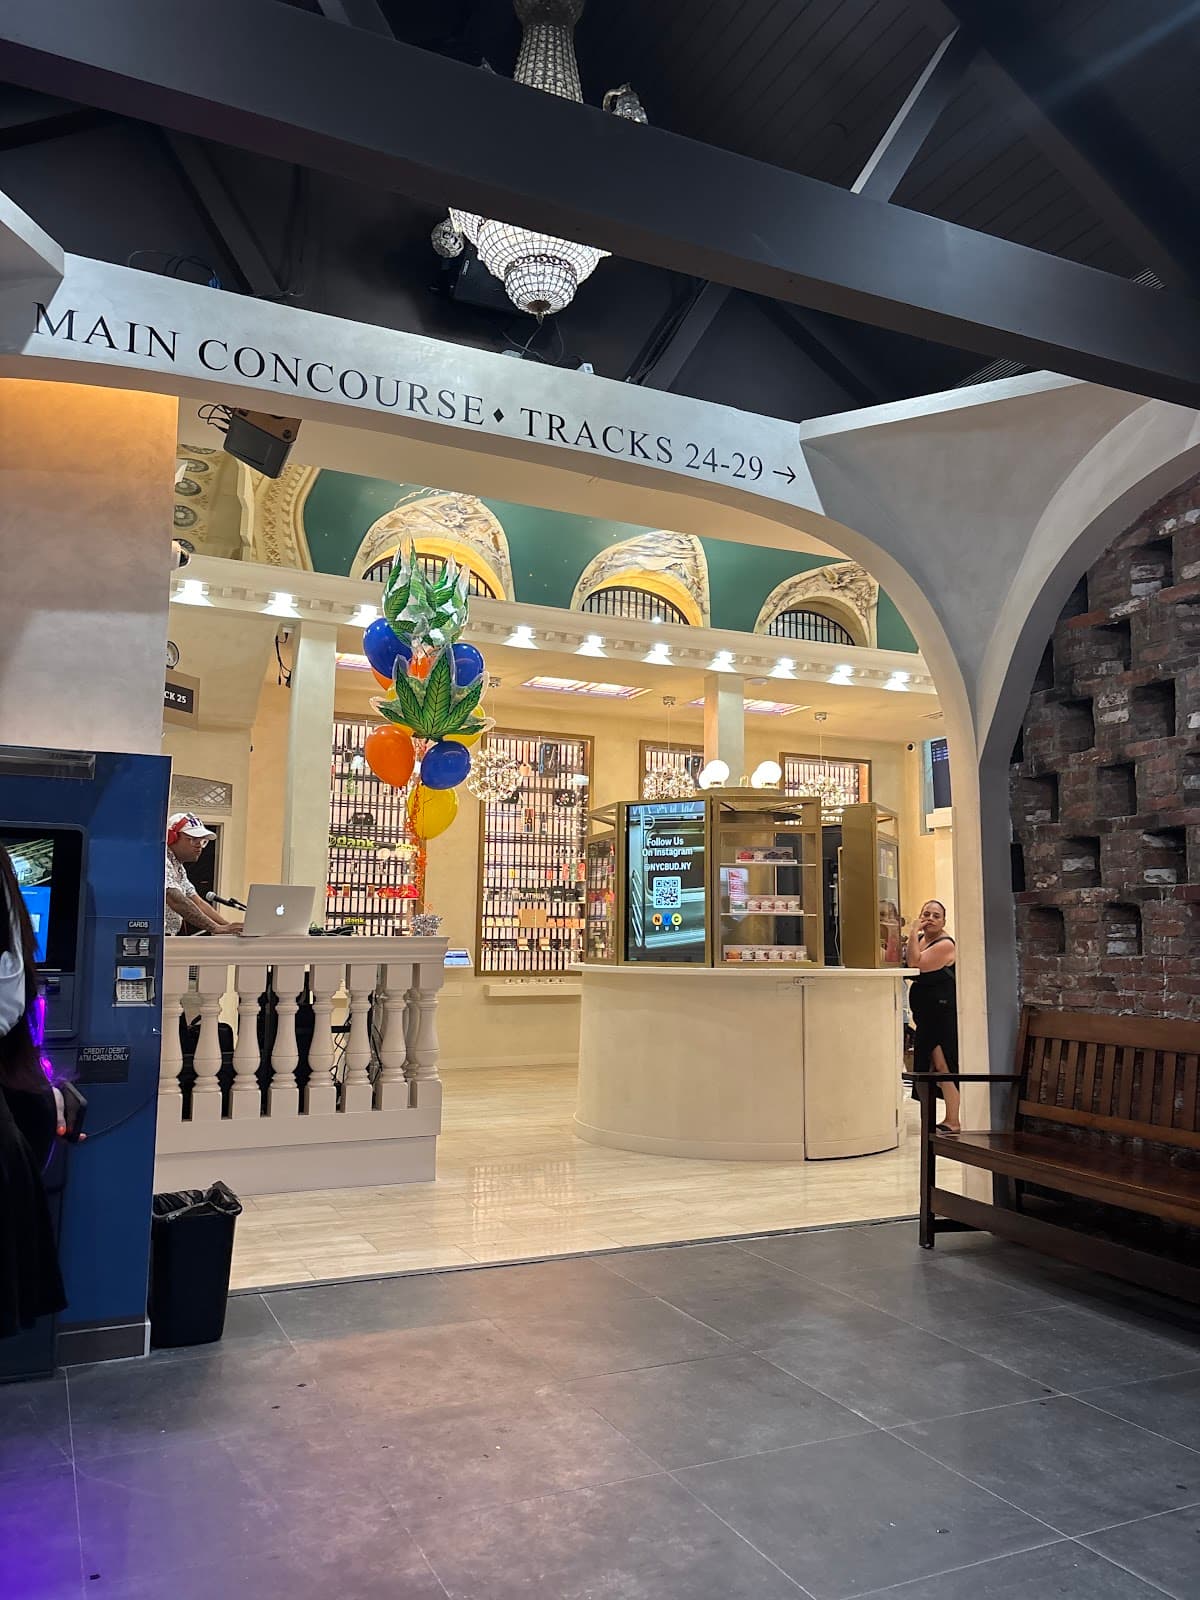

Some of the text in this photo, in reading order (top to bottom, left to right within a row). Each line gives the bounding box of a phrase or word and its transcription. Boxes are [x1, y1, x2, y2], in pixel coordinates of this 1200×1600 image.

[32, 301, 763, 481] MAIN CONCOURSE TRACKS 24-29
[177, 694, 187, 704] 25
[336, 835, 375, 848] dank
[646, 836, 684, 847] Follow Us
[642, 847, 693, 858] On Instagram
[644, 862, 692, 872] @NYCBUD.NY
[83, 1047, 105, 1055] CREDIT
[79, 1054, 92, 1062] ATM
[92, 1054, 113, 1062] CARDS
